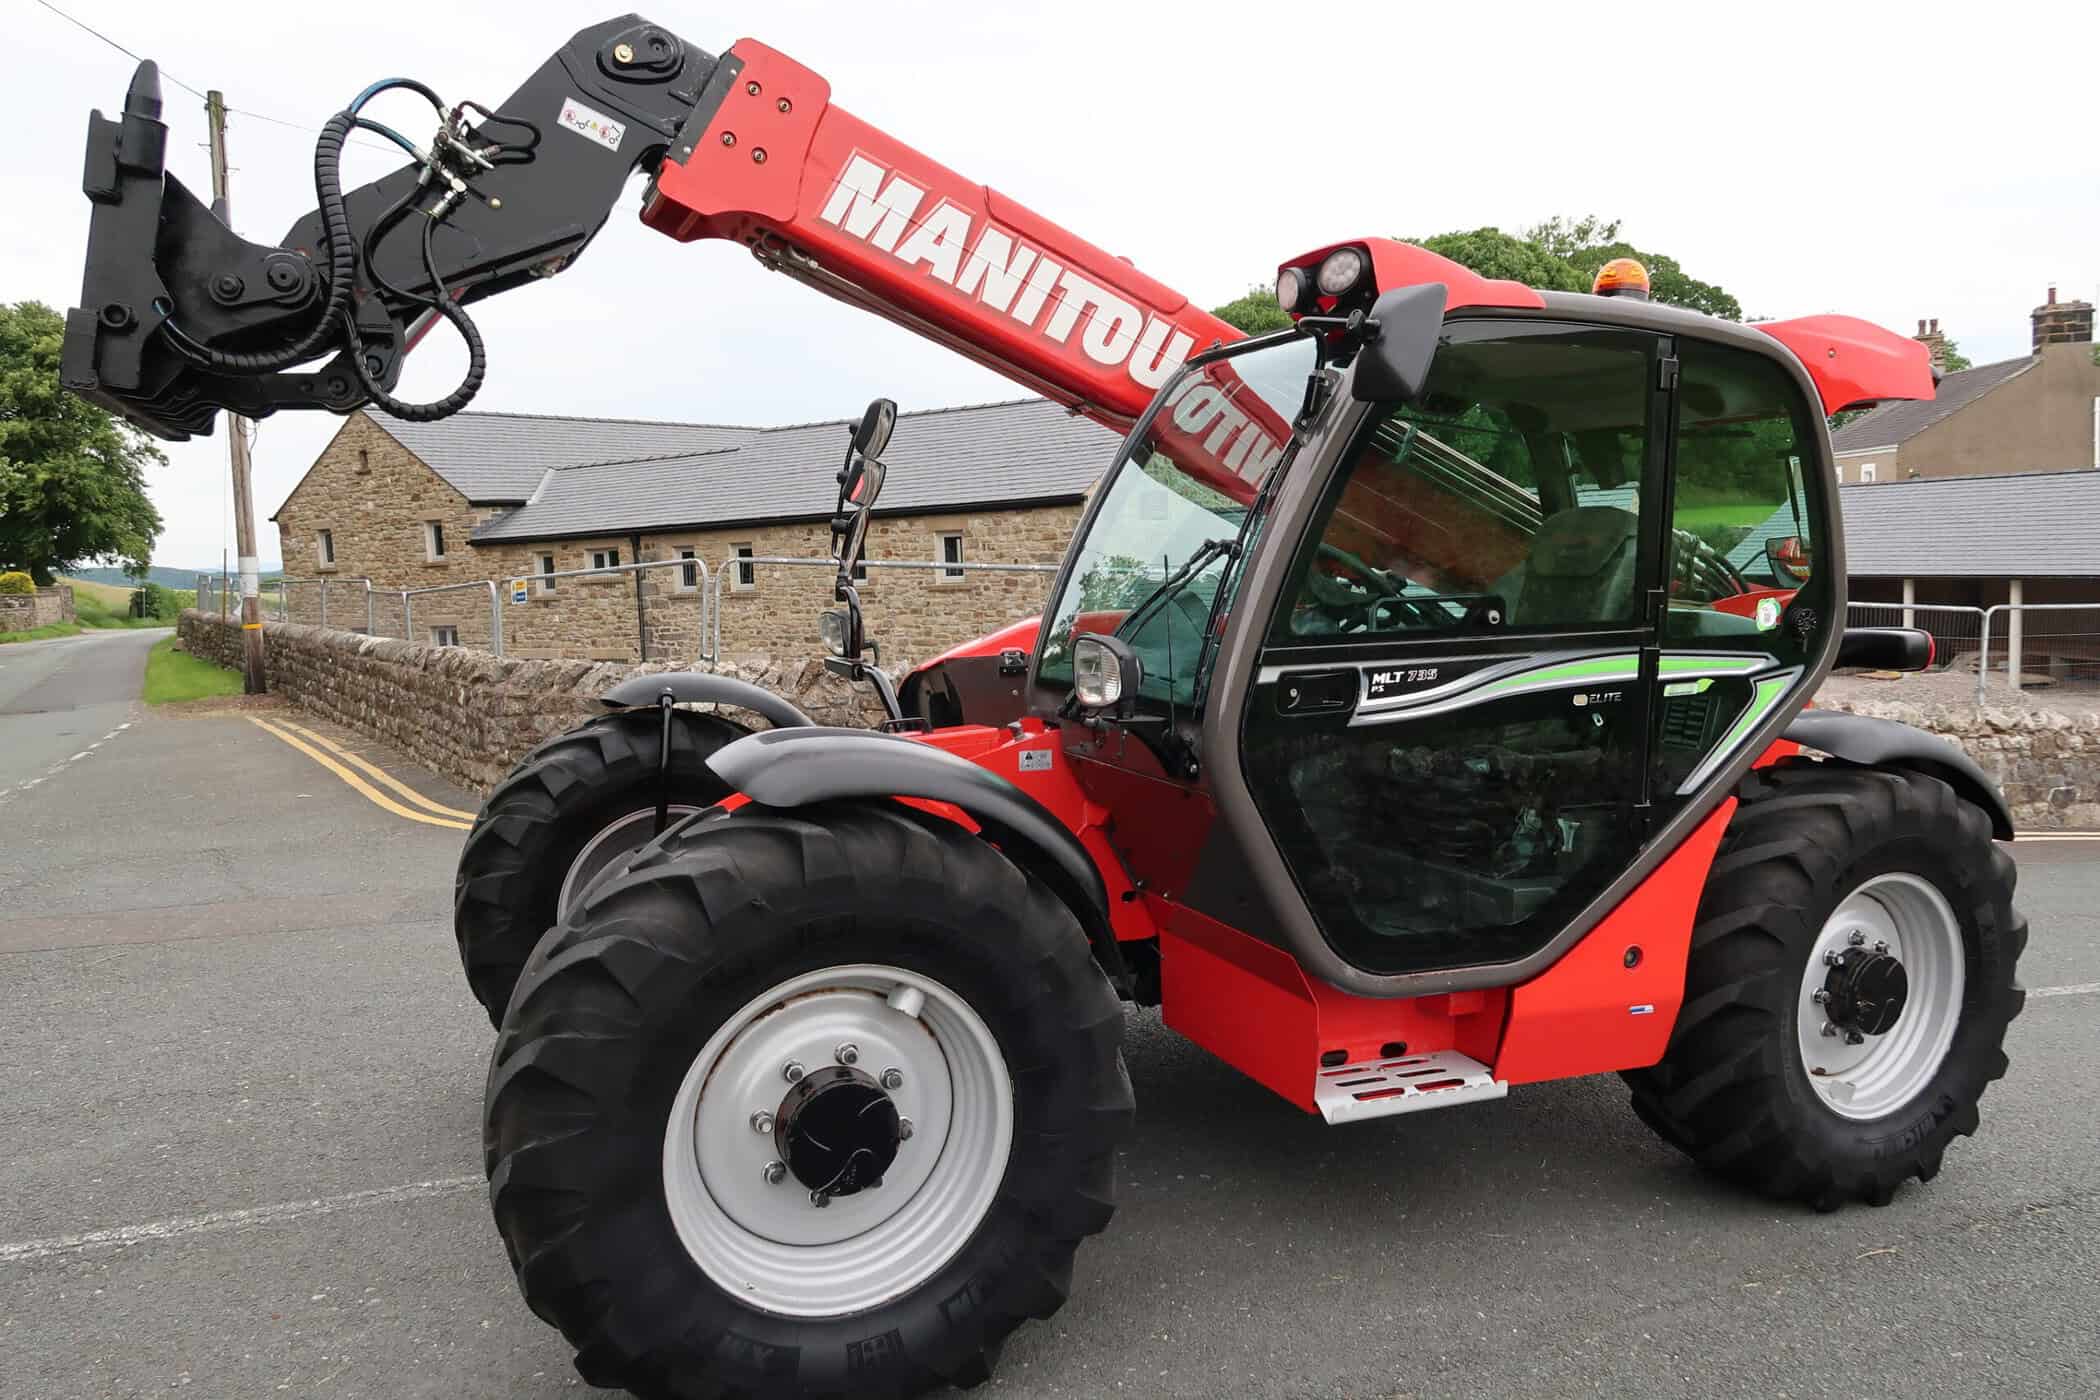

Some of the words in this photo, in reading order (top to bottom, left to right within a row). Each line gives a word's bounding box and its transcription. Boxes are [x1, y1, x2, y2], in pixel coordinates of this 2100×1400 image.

[819, 152, 1196, 390] MANITOU
[1372, 671, 1405, 685] MLT
[1589, 691, 1623, 705] ELITE
